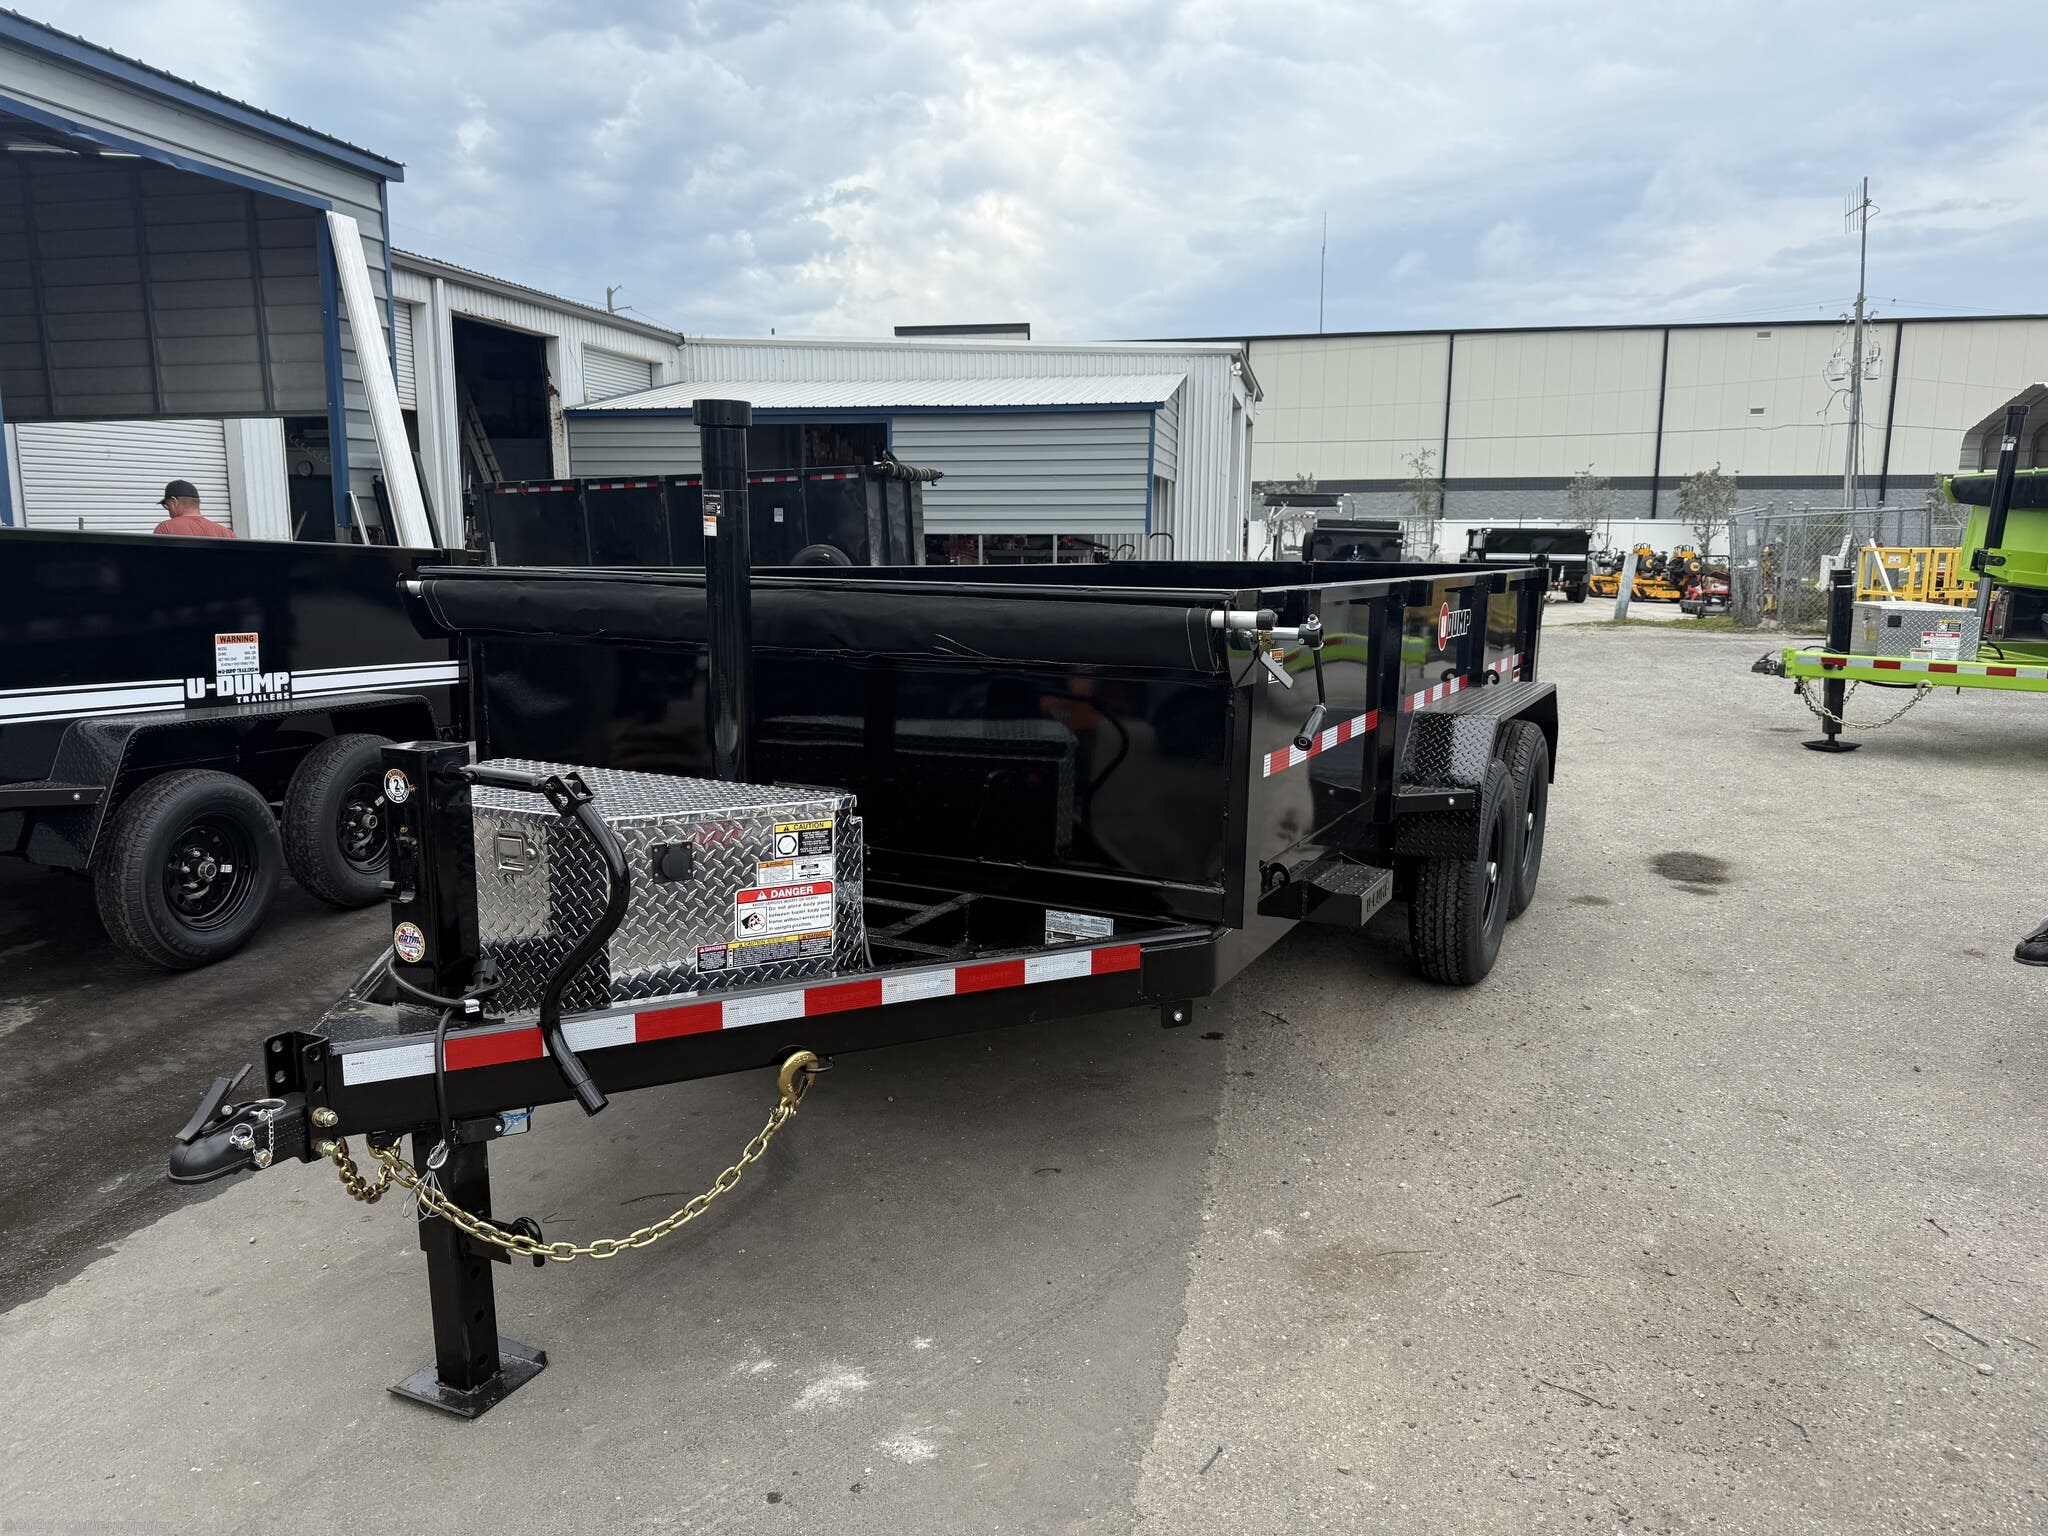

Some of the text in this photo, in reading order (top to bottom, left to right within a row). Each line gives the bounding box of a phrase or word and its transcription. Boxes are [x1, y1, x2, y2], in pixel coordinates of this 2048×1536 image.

[220, 635, 254, 643] WARNING
[236, 693, 290, 704] TRAILERS
[771, 886, 814, 898] DANGER
